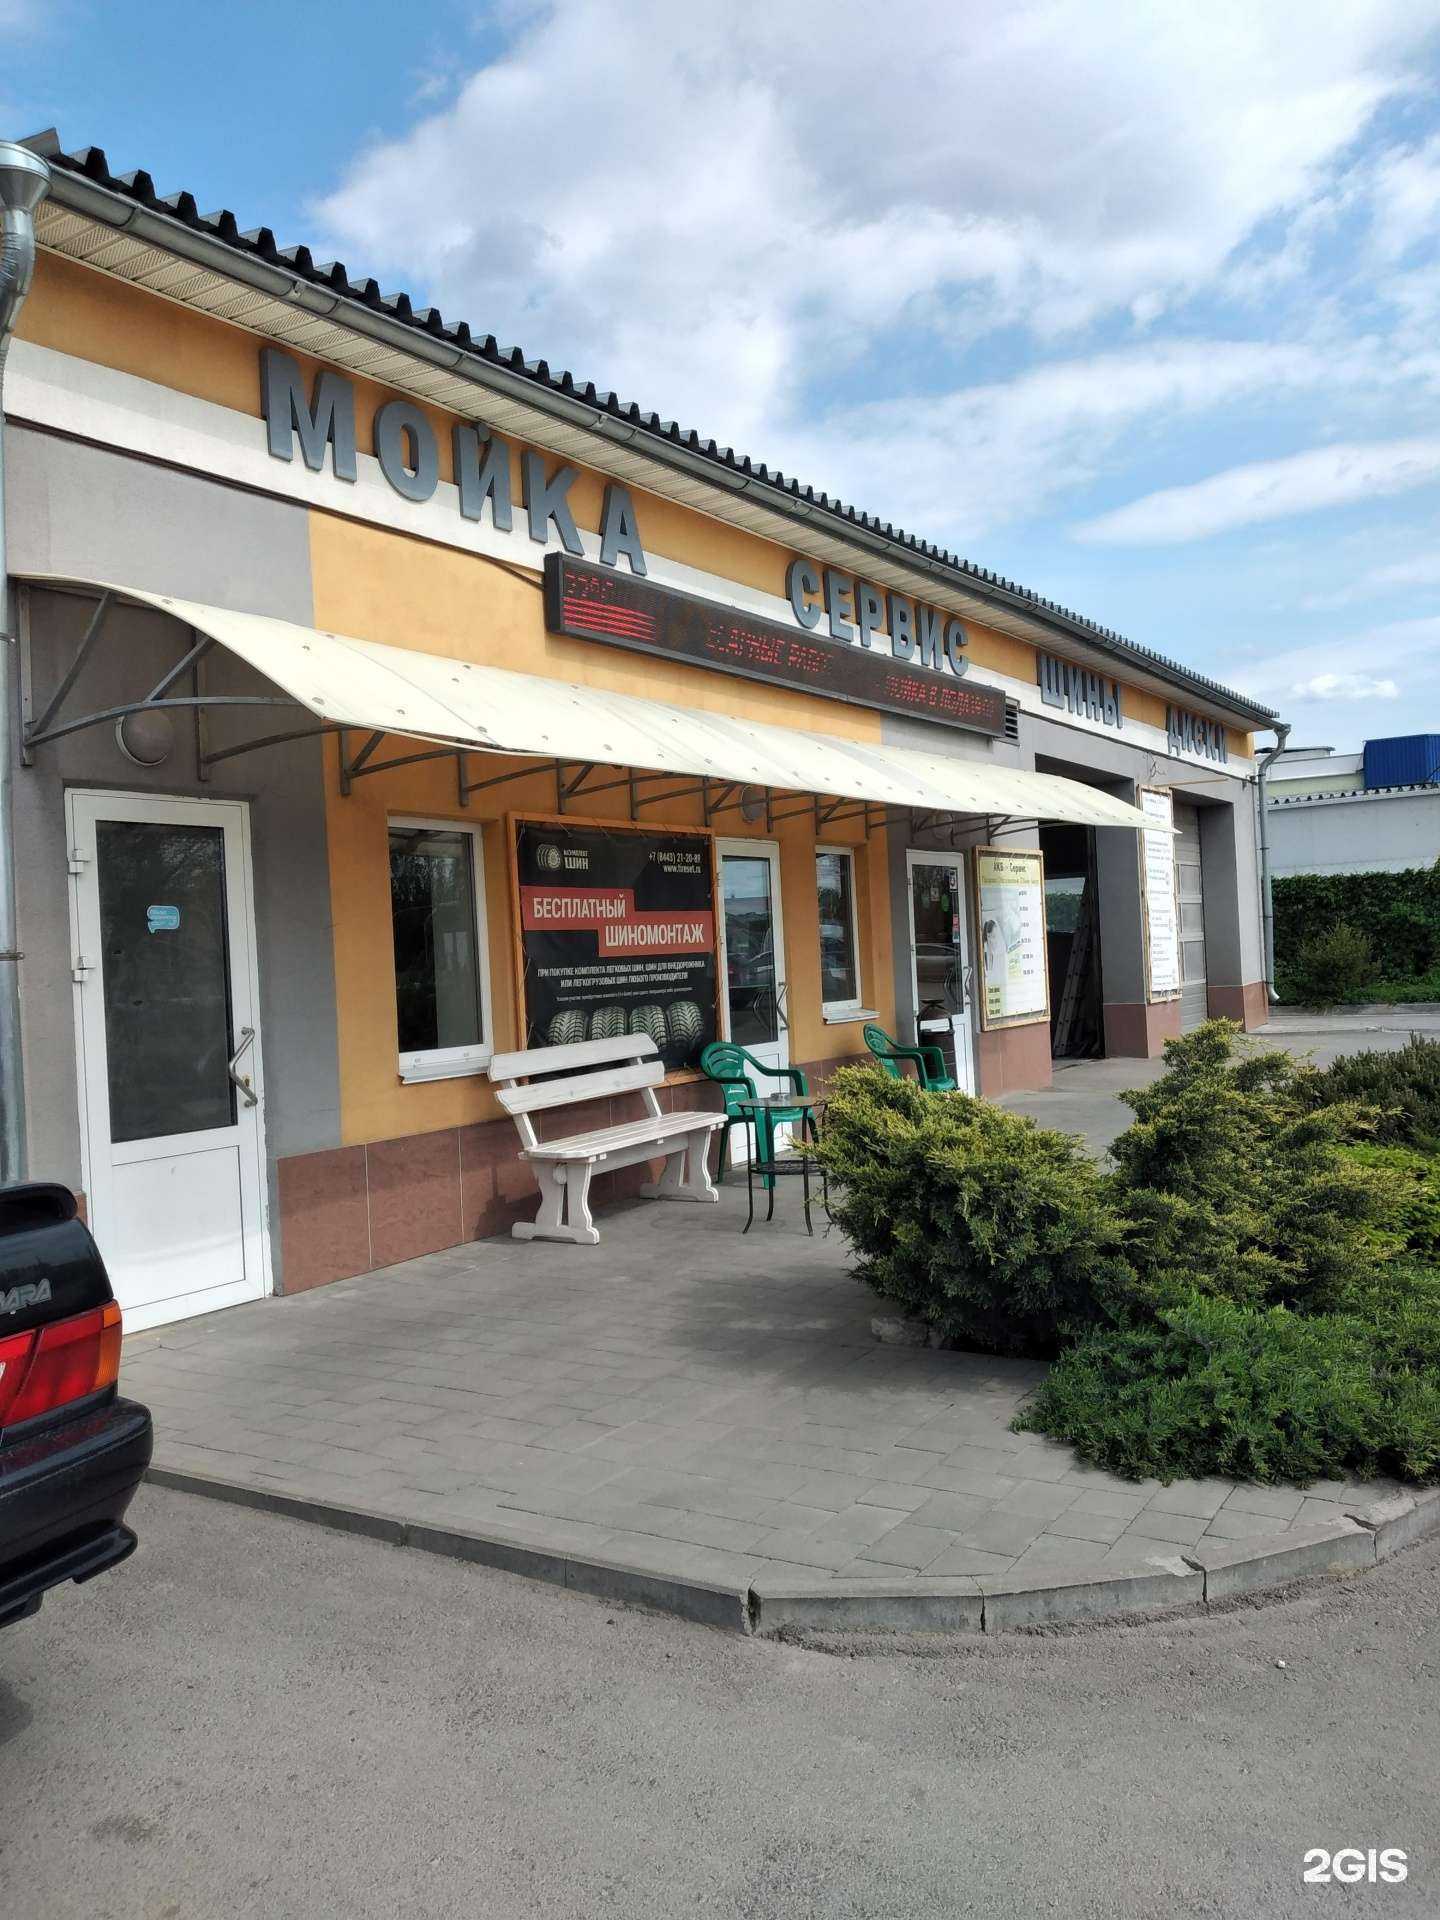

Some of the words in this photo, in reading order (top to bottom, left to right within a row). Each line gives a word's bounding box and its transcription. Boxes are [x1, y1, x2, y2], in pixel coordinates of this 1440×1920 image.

[259, 347, 648, 577] МОЙКА
[785, 559, 969, 677] СЕРВИС
[1038, 652, 1123, 730] ШИНЫ
[1165, 703, 1228, 764] ДИСКИ
[564, 856, 589, 870] ШИН
[649, 851, 656, 862] +7
[533, 894, 626, 919] БЕСПЛАТНЫЙ
[605, 923, 704, 947] ШИНОМОНТАЖ
[537, 968, 549, 977] ПРИ
[550, 967, 574, 977] ПОКУПКЕ
[575, 966, 606, 976] КОМПЛЕКТА
[560, 978, 572, 988] ИЛИ
